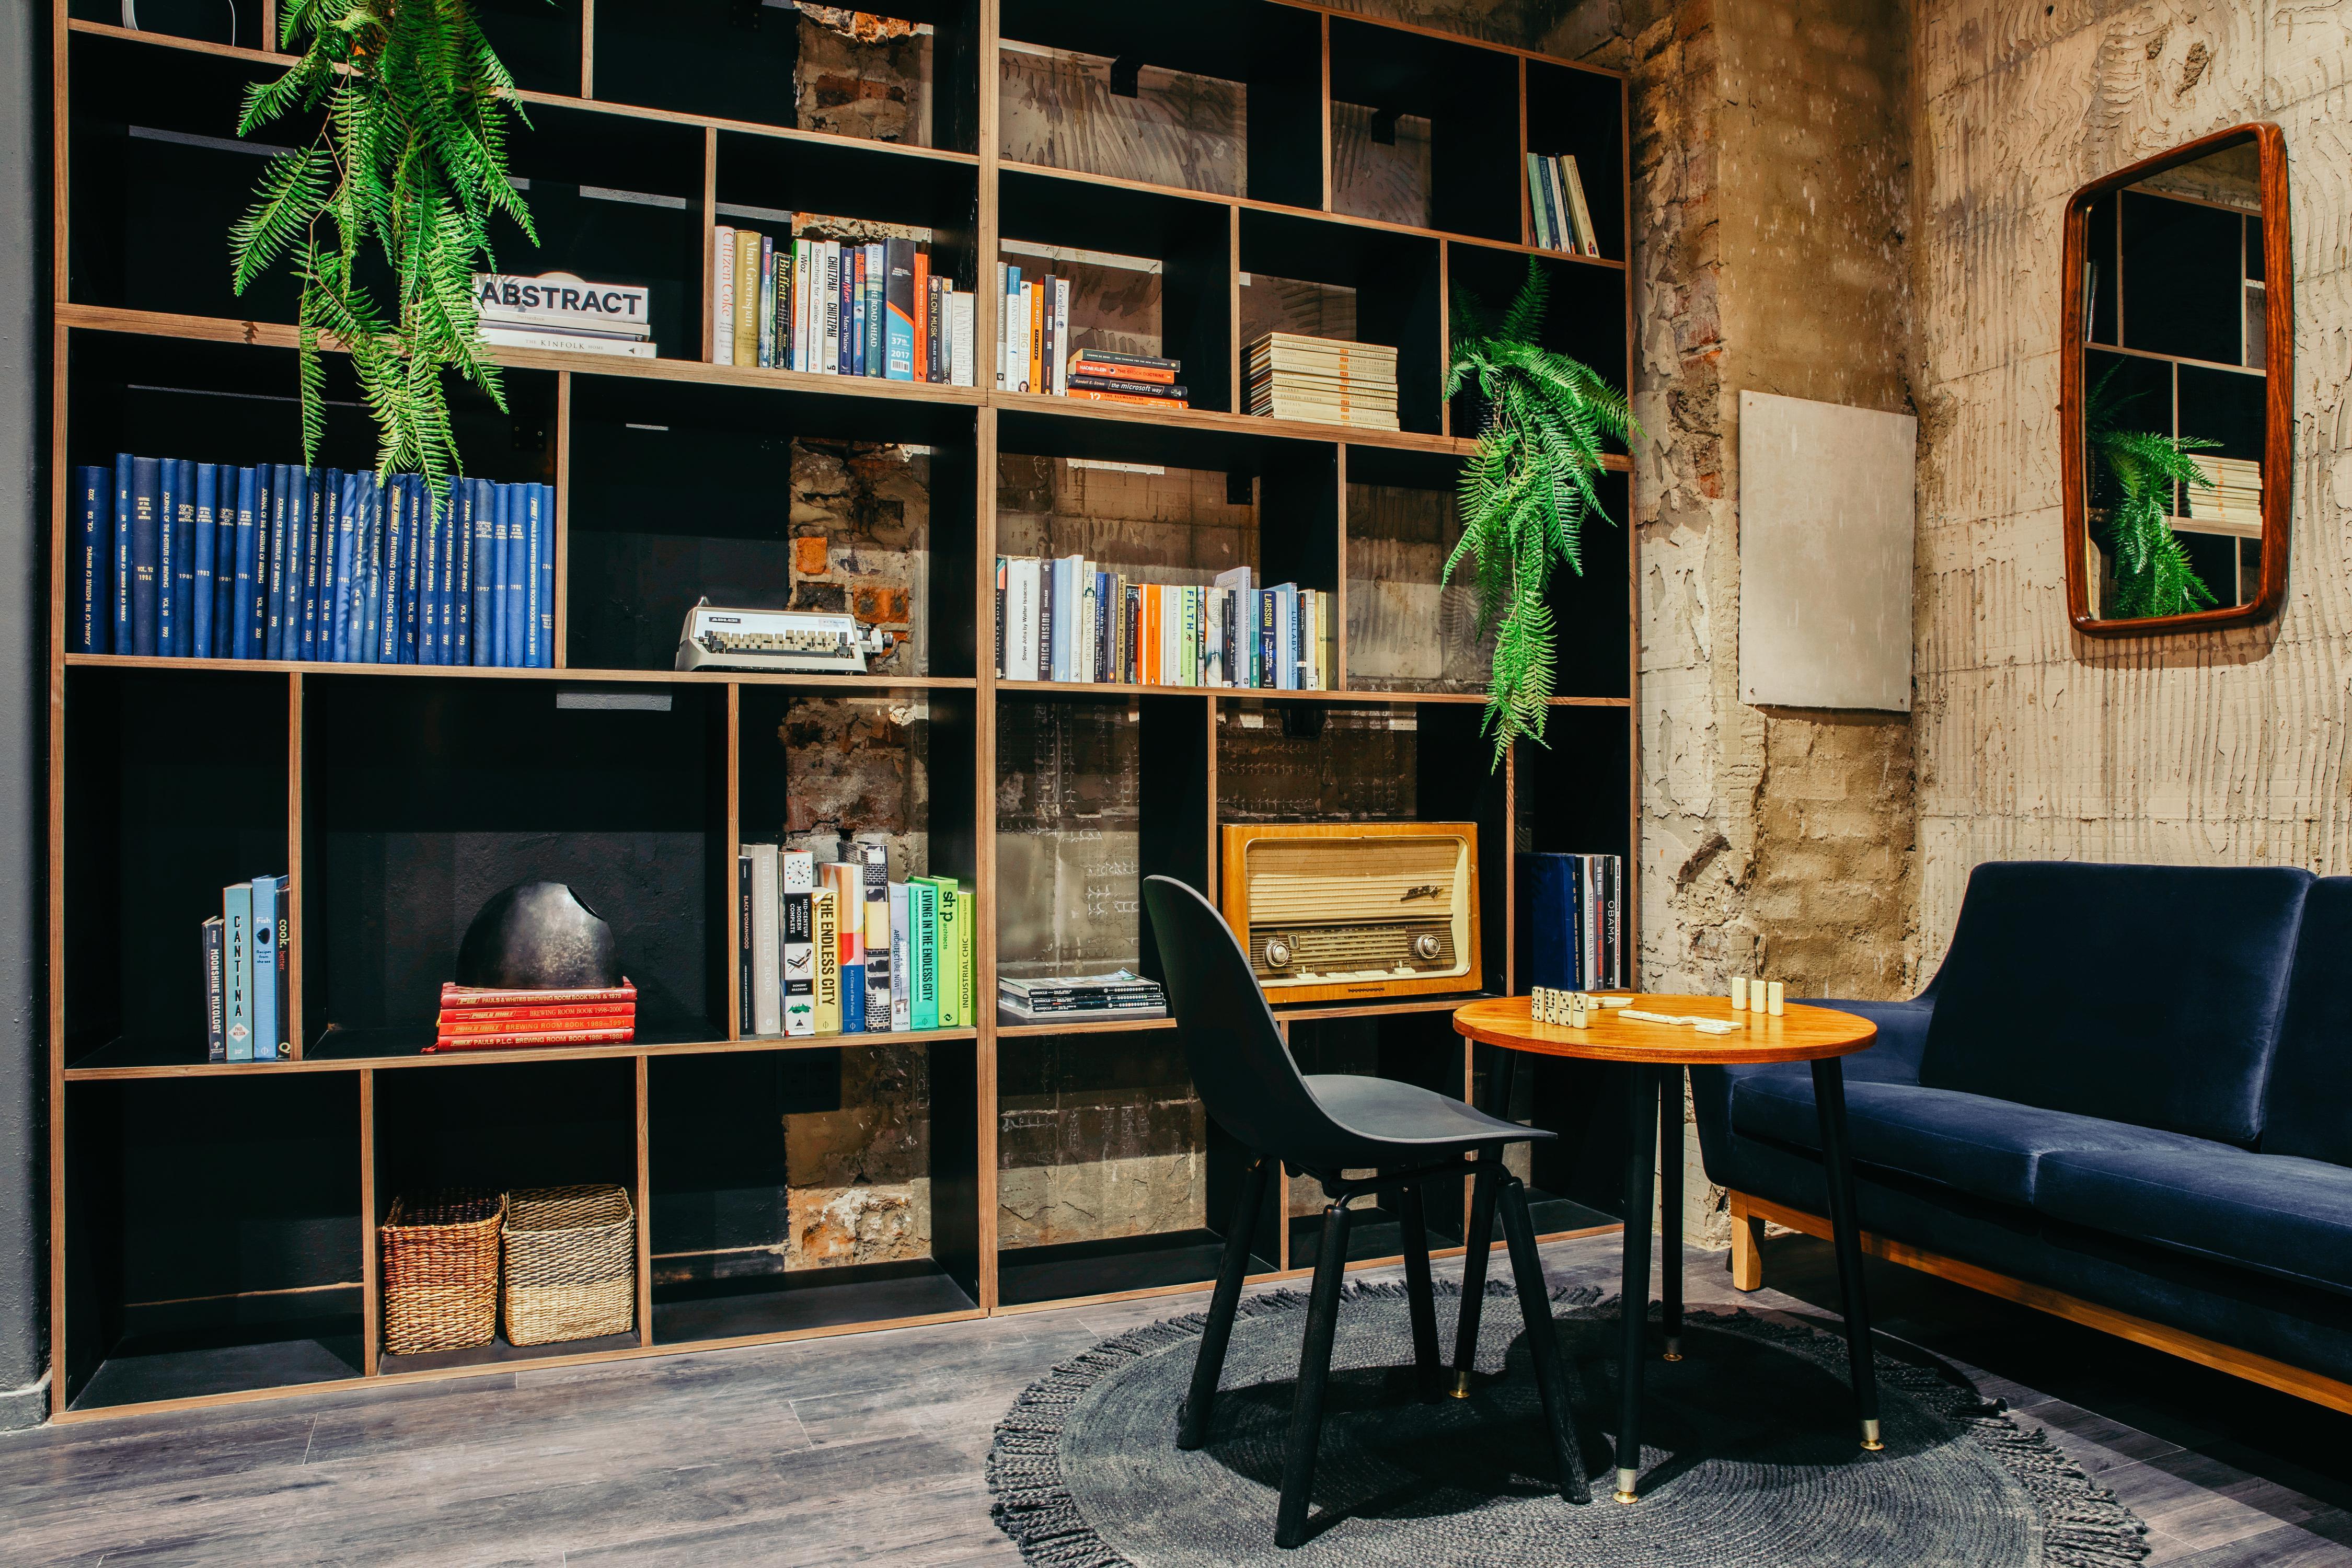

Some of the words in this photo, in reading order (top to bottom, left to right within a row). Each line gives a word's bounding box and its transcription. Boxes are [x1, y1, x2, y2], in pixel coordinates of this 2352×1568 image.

[723, 233, 733, 280] Citizen
[746, 239, 757, 264] Alan
[778, 258, 790, 301] Buffett
[827, 256, 838, 291] CHUTZPAH
[480, 282, 642, 315] ABSTRACT
[722, 284, 733, 316] Coke
[742, 268, 757, 327] Greenspan
[827, 291, 837, 301] &
[827, 303, 837, 338] CHUTZPAH
[1021, 294, 1029, 332] PLAYING
[540, 340, 585, 350] KINFOLK
[891, 350, 910, 359] 2017
[1121, 383, 1150, 392] microsoft
[86, 569, 92, 578] OF
[388, 569, 396, 592] ROOM
[85, 612, 91, 621] OF
[1041, 613, 1050, 640] RISING
[1096, 621, 1100, 630] WE
[1041, 642, 1050, 671] AFRICA
[821, 895, 834, 919] THE
[922, 890, 932, 918] LIVING
[279, 919, 290, 948] cook.
[923, 920, 932, 929] IN
[923, 930, 932, 946] THE
[821, 921, 835, 975] ENDLESS
[211, 949, 220, 994] MOONSHINE
[234, 916, 243, 1017] CANTINA
[923, 948, 932, 983] ENDLESS
[822, 978, 835, 1006] CITY
[923, 984, 932, 1001] CITY
[211, 996, 221, 1034] MIXOLOGY
